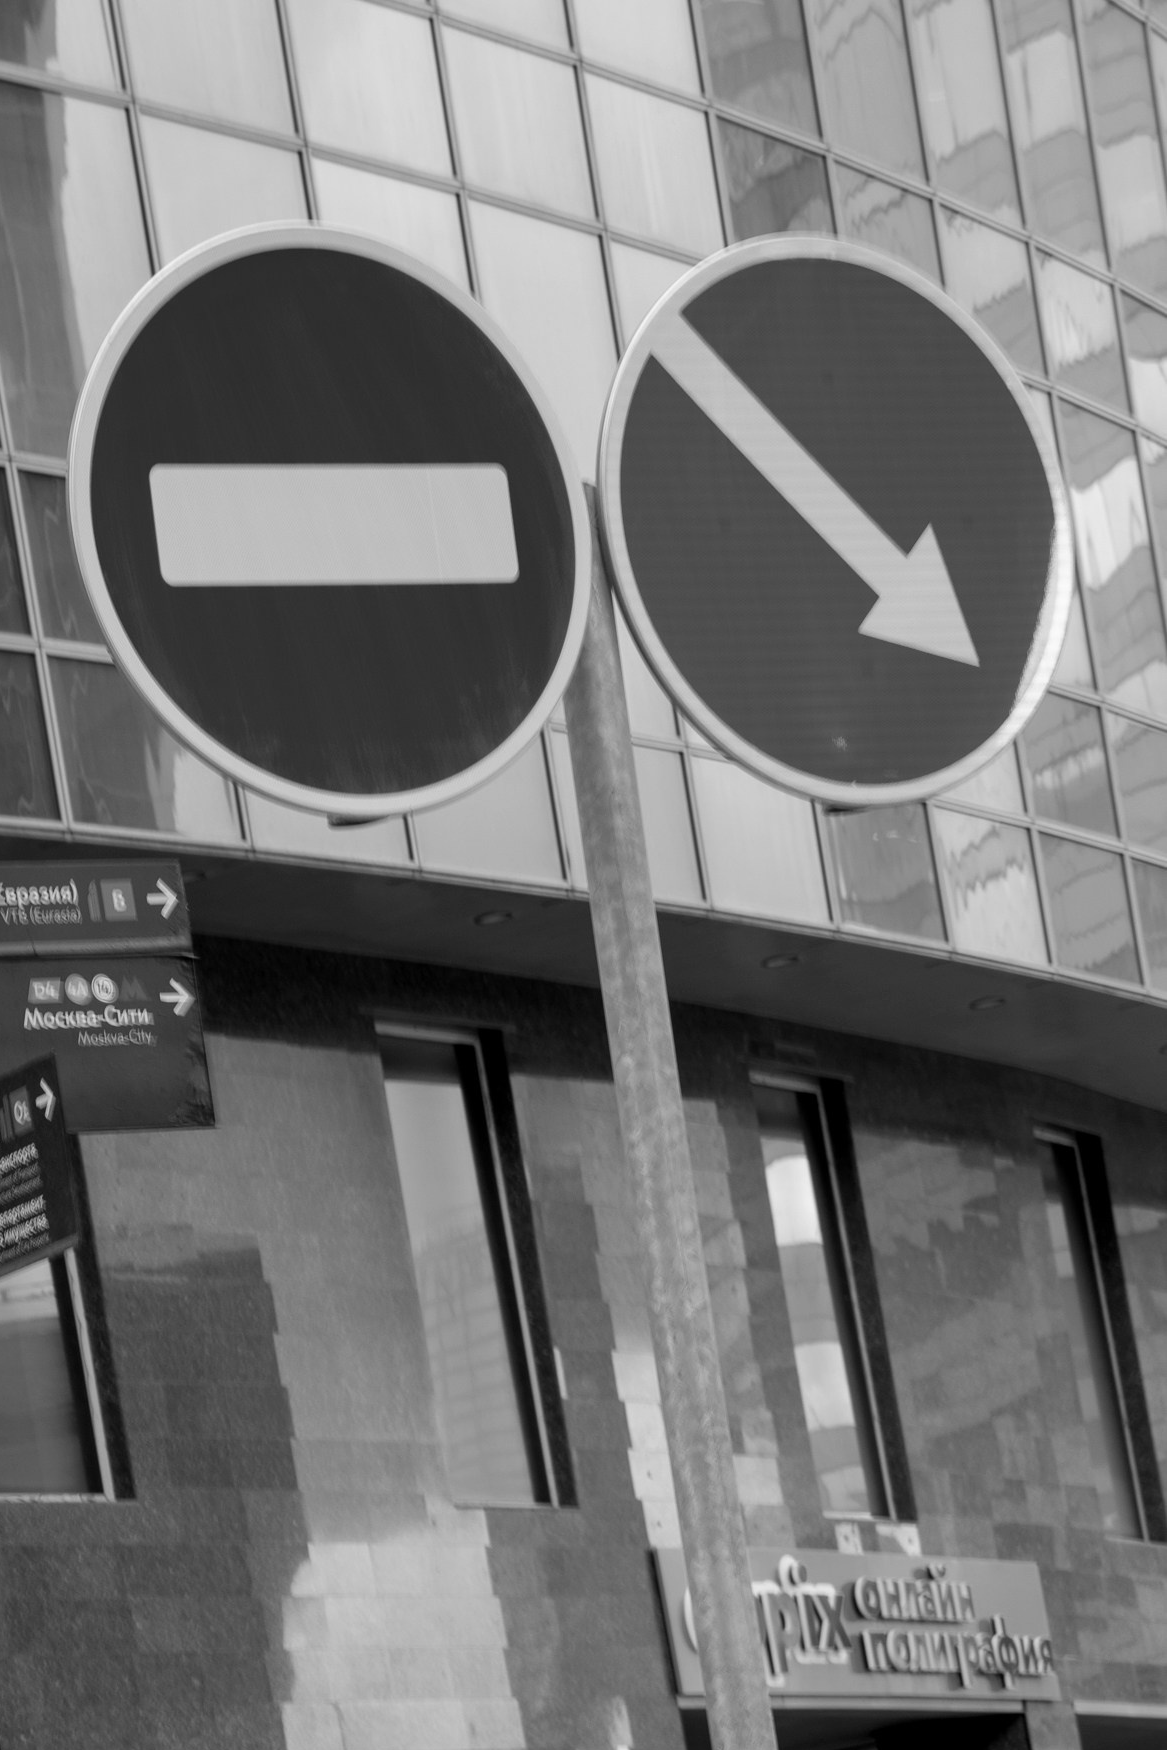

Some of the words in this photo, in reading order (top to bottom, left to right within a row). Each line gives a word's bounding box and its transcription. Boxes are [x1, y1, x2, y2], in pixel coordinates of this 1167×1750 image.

[0, 906, 29, 925] VTB
[24, 1005, 154, 1030] Москва-Сити
[78, 1028, 156, 1047] Moskva-City
[854, 1562, 976, 1622] онлайн
[862, 1614, 1054, 1689] полиграфия
